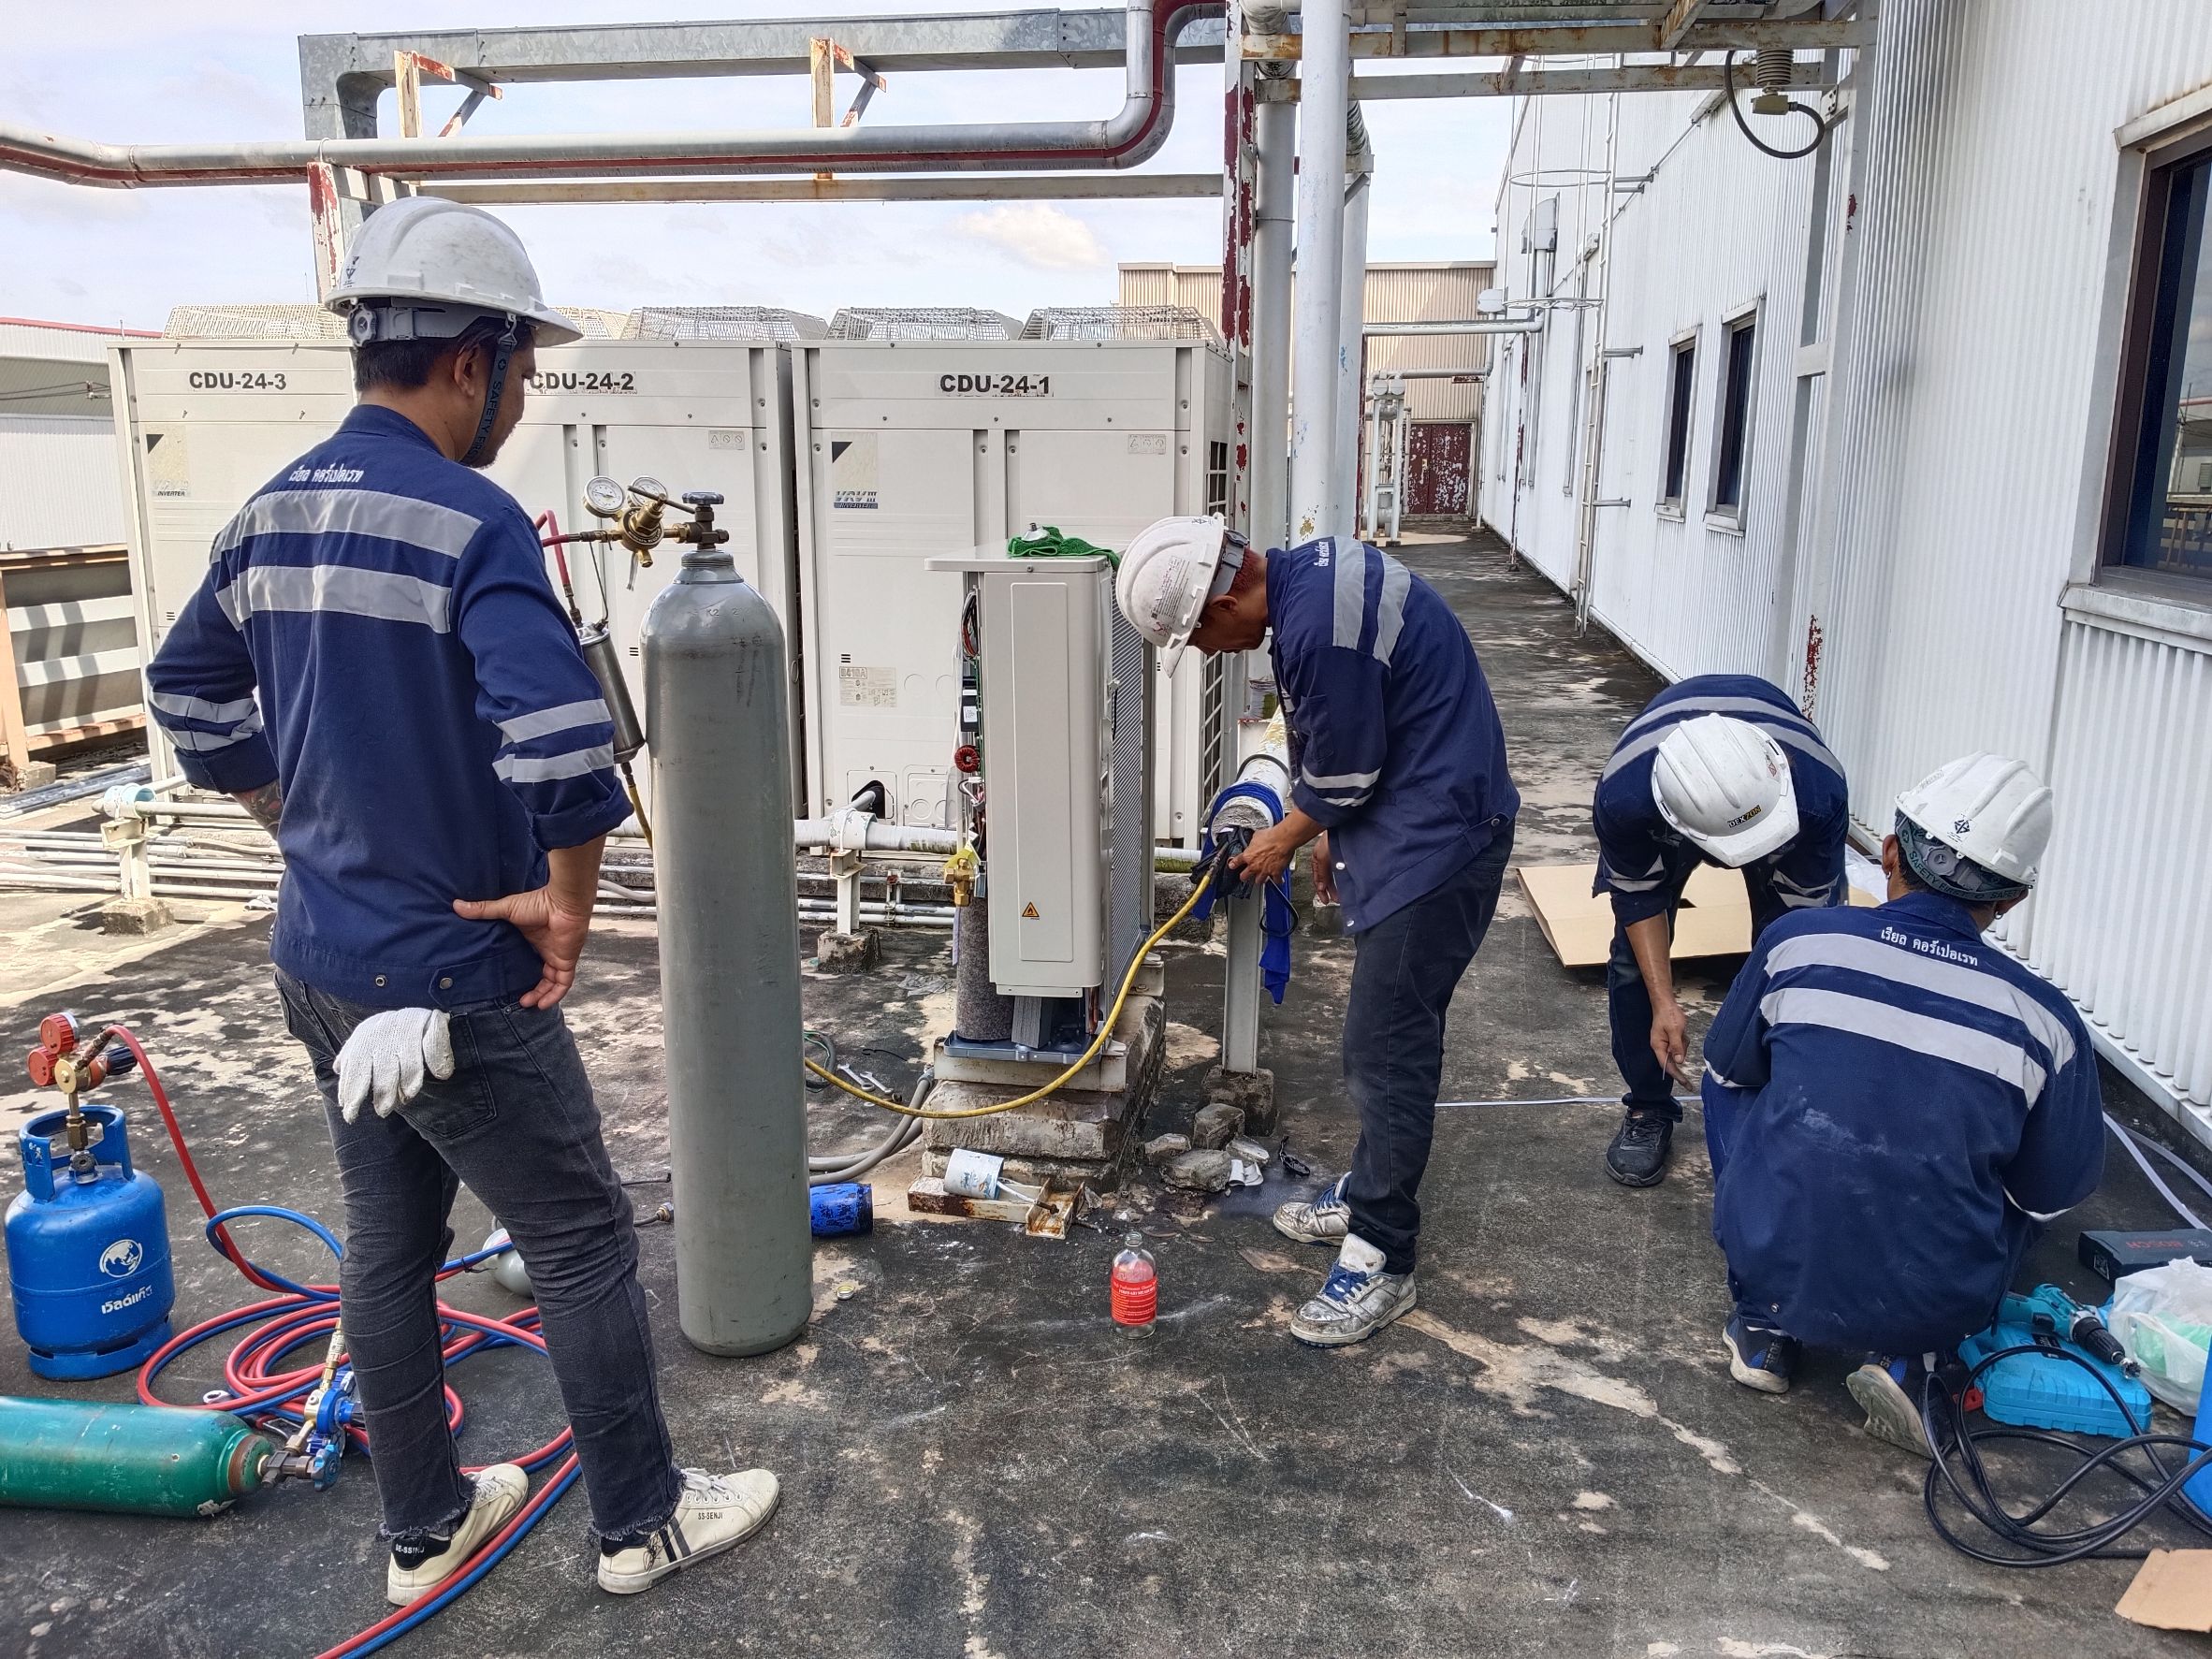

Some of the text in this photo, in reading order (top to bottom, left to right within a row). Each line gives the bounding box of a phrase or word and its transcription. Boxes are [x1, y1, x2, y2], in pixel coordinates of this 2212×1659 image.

[189, 372, 286, 390] CDU-24-3
[529, 371, 634, 390] CDU-24-2
[939, 374, 1049, 394] CDU-24-1
[467, 380, 502, 460] SAFETY FIRS
[1728, 805, 1762, 828] DEXZON
[1909, 851, 1938, 884] SAFETY
[1989, 889, 2017, 899] SAFET
[1881, 926, 1978, 967] เรียล คอร์เปอเรท
[698, 1512, 723, 1521] SS-SENJI
